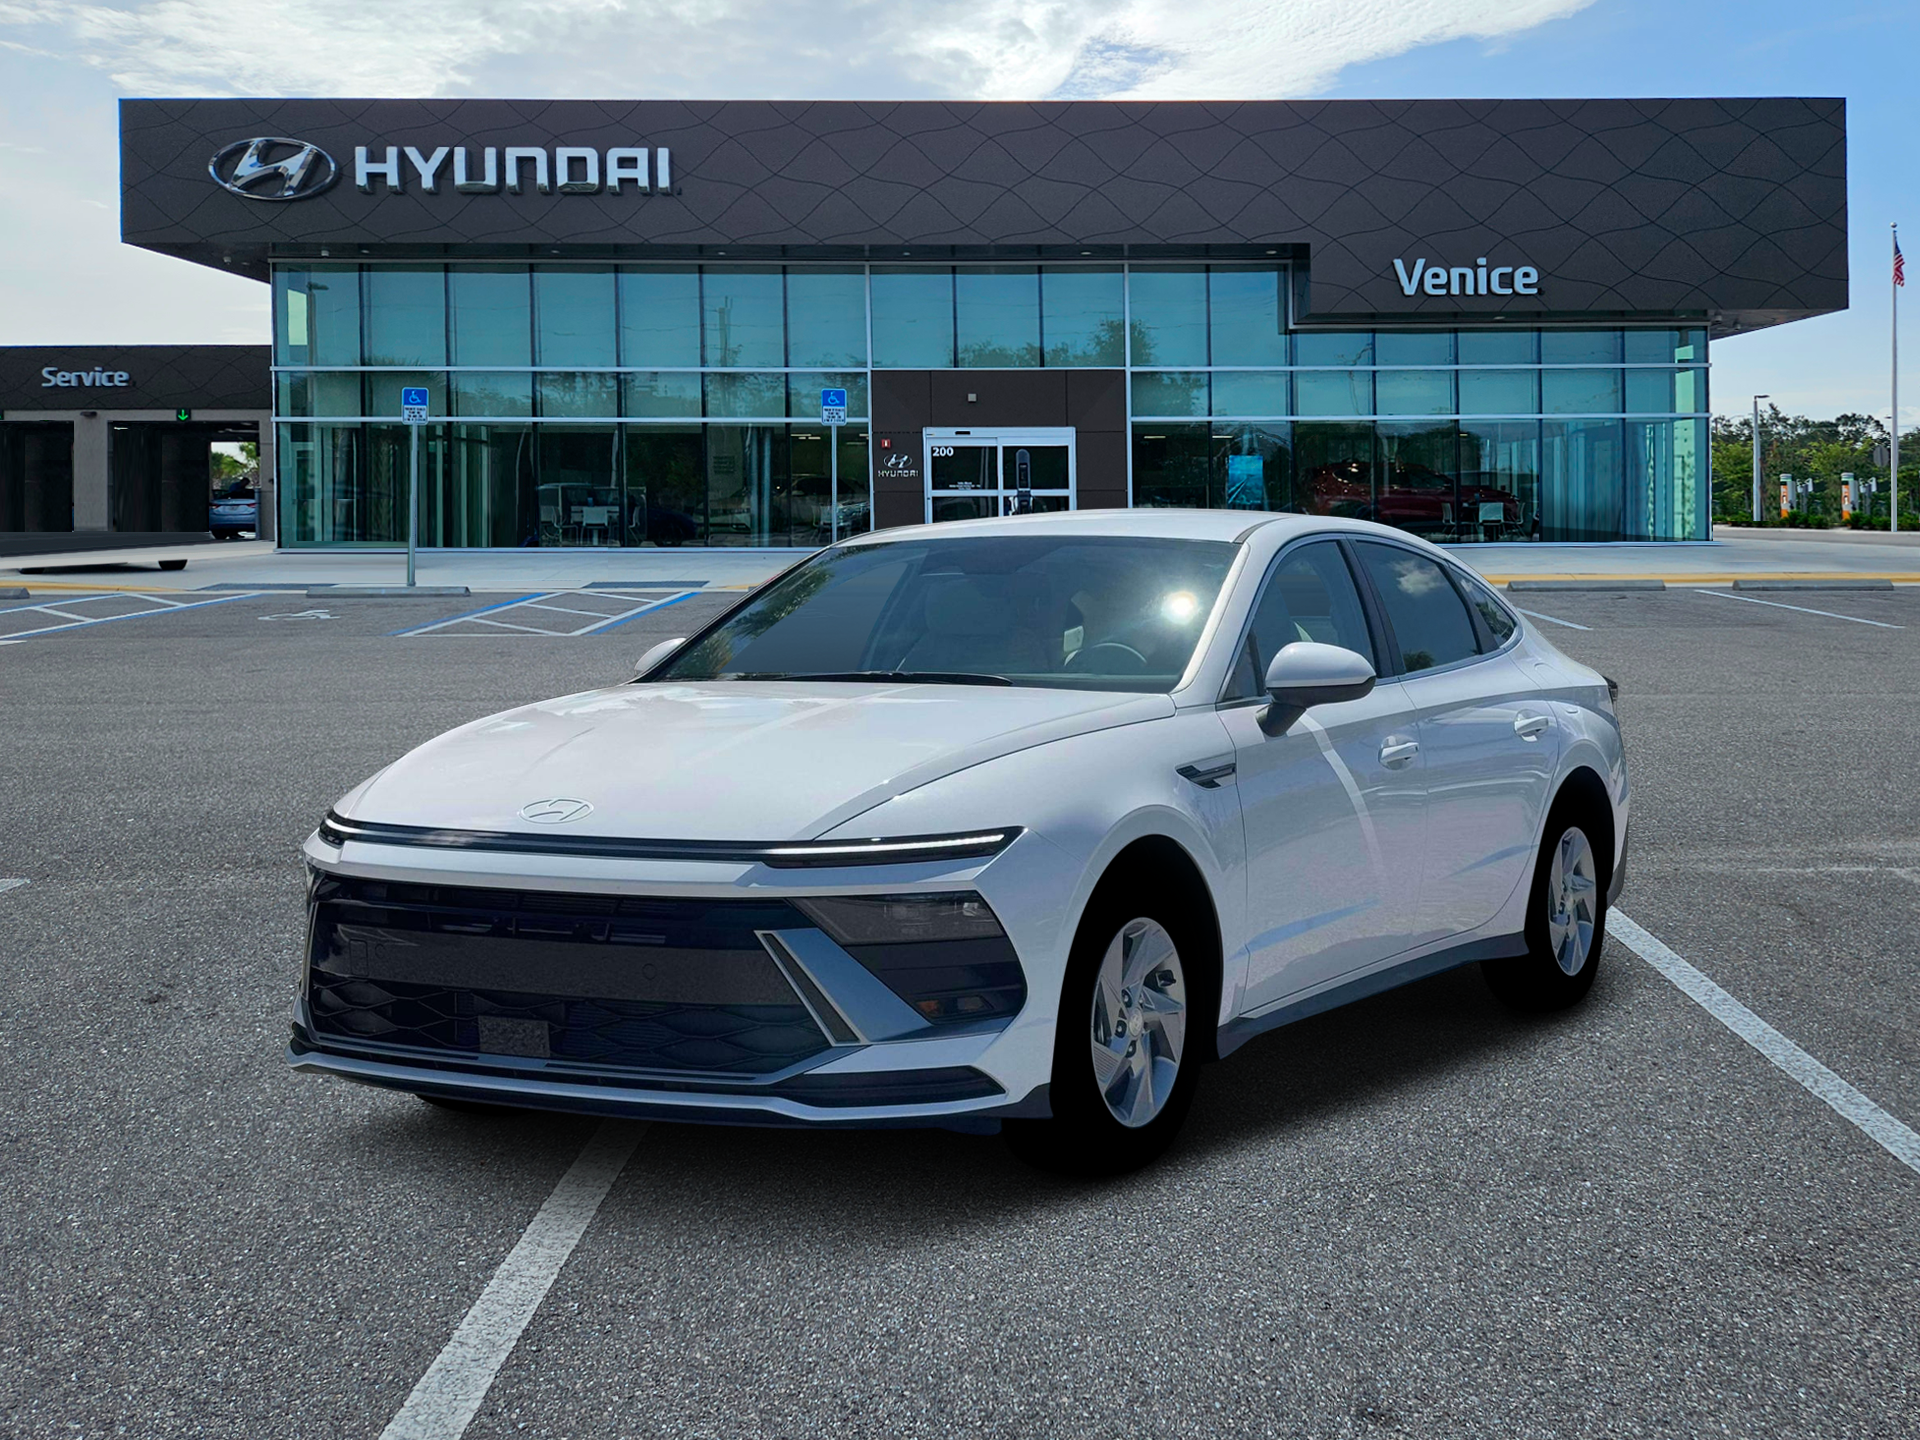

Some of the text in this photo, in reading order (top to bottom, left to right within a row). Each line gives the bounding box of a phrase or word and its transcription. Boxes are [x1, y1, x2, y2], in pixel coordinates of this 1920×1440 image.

[354, 146, 671, 195] HYUNDAI
[1393, 257, 1539, 296] Venice
[41, 366, 130, 388] Service
[932, 446, 954, 457] 200
